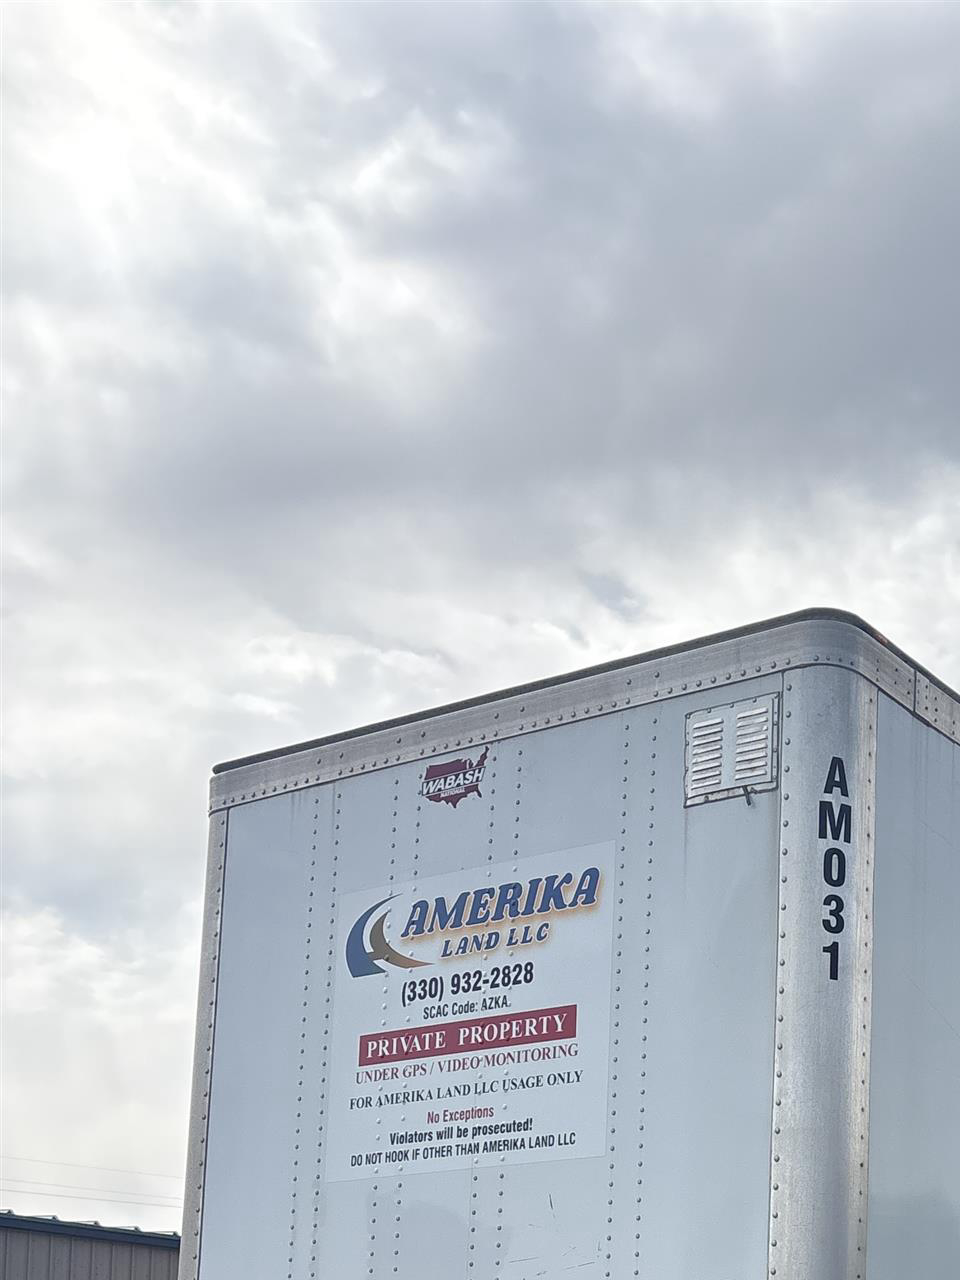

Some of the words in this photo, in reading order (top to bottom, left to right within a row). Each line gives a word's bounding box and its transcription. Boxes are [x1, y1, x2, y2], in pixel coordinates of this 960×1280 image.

[422, 767, 485, 796] WABASH
[818, 756, 852, 981] AM031
[400, 866, 600, 938] AMERIKA
[441, 931, 500, 957] LAND
[506, 922, 550, 947] LLC
[402, 976, 444, 1008] (330)
[450, 961, 535, 996] 932-2828
[423, 1003, 449, 1020] SCAC
[452, 1000, 479, 1016] Code:
[365, 1030, 447, 1059] PRIVATE
[458, 1012, 568, 1047] PROPERTY
[356, 1067, 399, 1085] UNDER
[402, 1063, 428, 1079] GPS
[438, 1056, 480, 1073] VIDEO
[483, 1043, 579, 1068] MONITORING
[349, 1096, 373, 1110] FOR
[375, 1089, 433, 1107] AMERIKA
[436, 1083, 471, 1100] LAND
[474, 1080, 499, 1096] LLC
[502, 1075, 544, 1092] USAGE
[547, 1070, 584, 1087] ONLY
[390, 1130, 433, 1145] Violators
[436, 1126, 454, 1141] will
[456, 1125, 469, 1139] be
[471, 1117, 534, 1140] prosecuted!
[427, 1111, 440, 1124] No
[443, 1105, 495, 1123] Exceptions
[350, 1154, 363, 1167] DO
[365, 1152, 383, 1166] NOT
[385, 1149, 410, 1164] HOOK
[411, 1148, 421, 1161] IF
[422, 1144, 453, 1160] OTHER
[455, 1141, 480, 1156] THAN
[482, 1137, 526, 1154] AMERIKA
[528, 1134, 555, 1149] LAND
[557, 1131, 577, 1146] LLC
